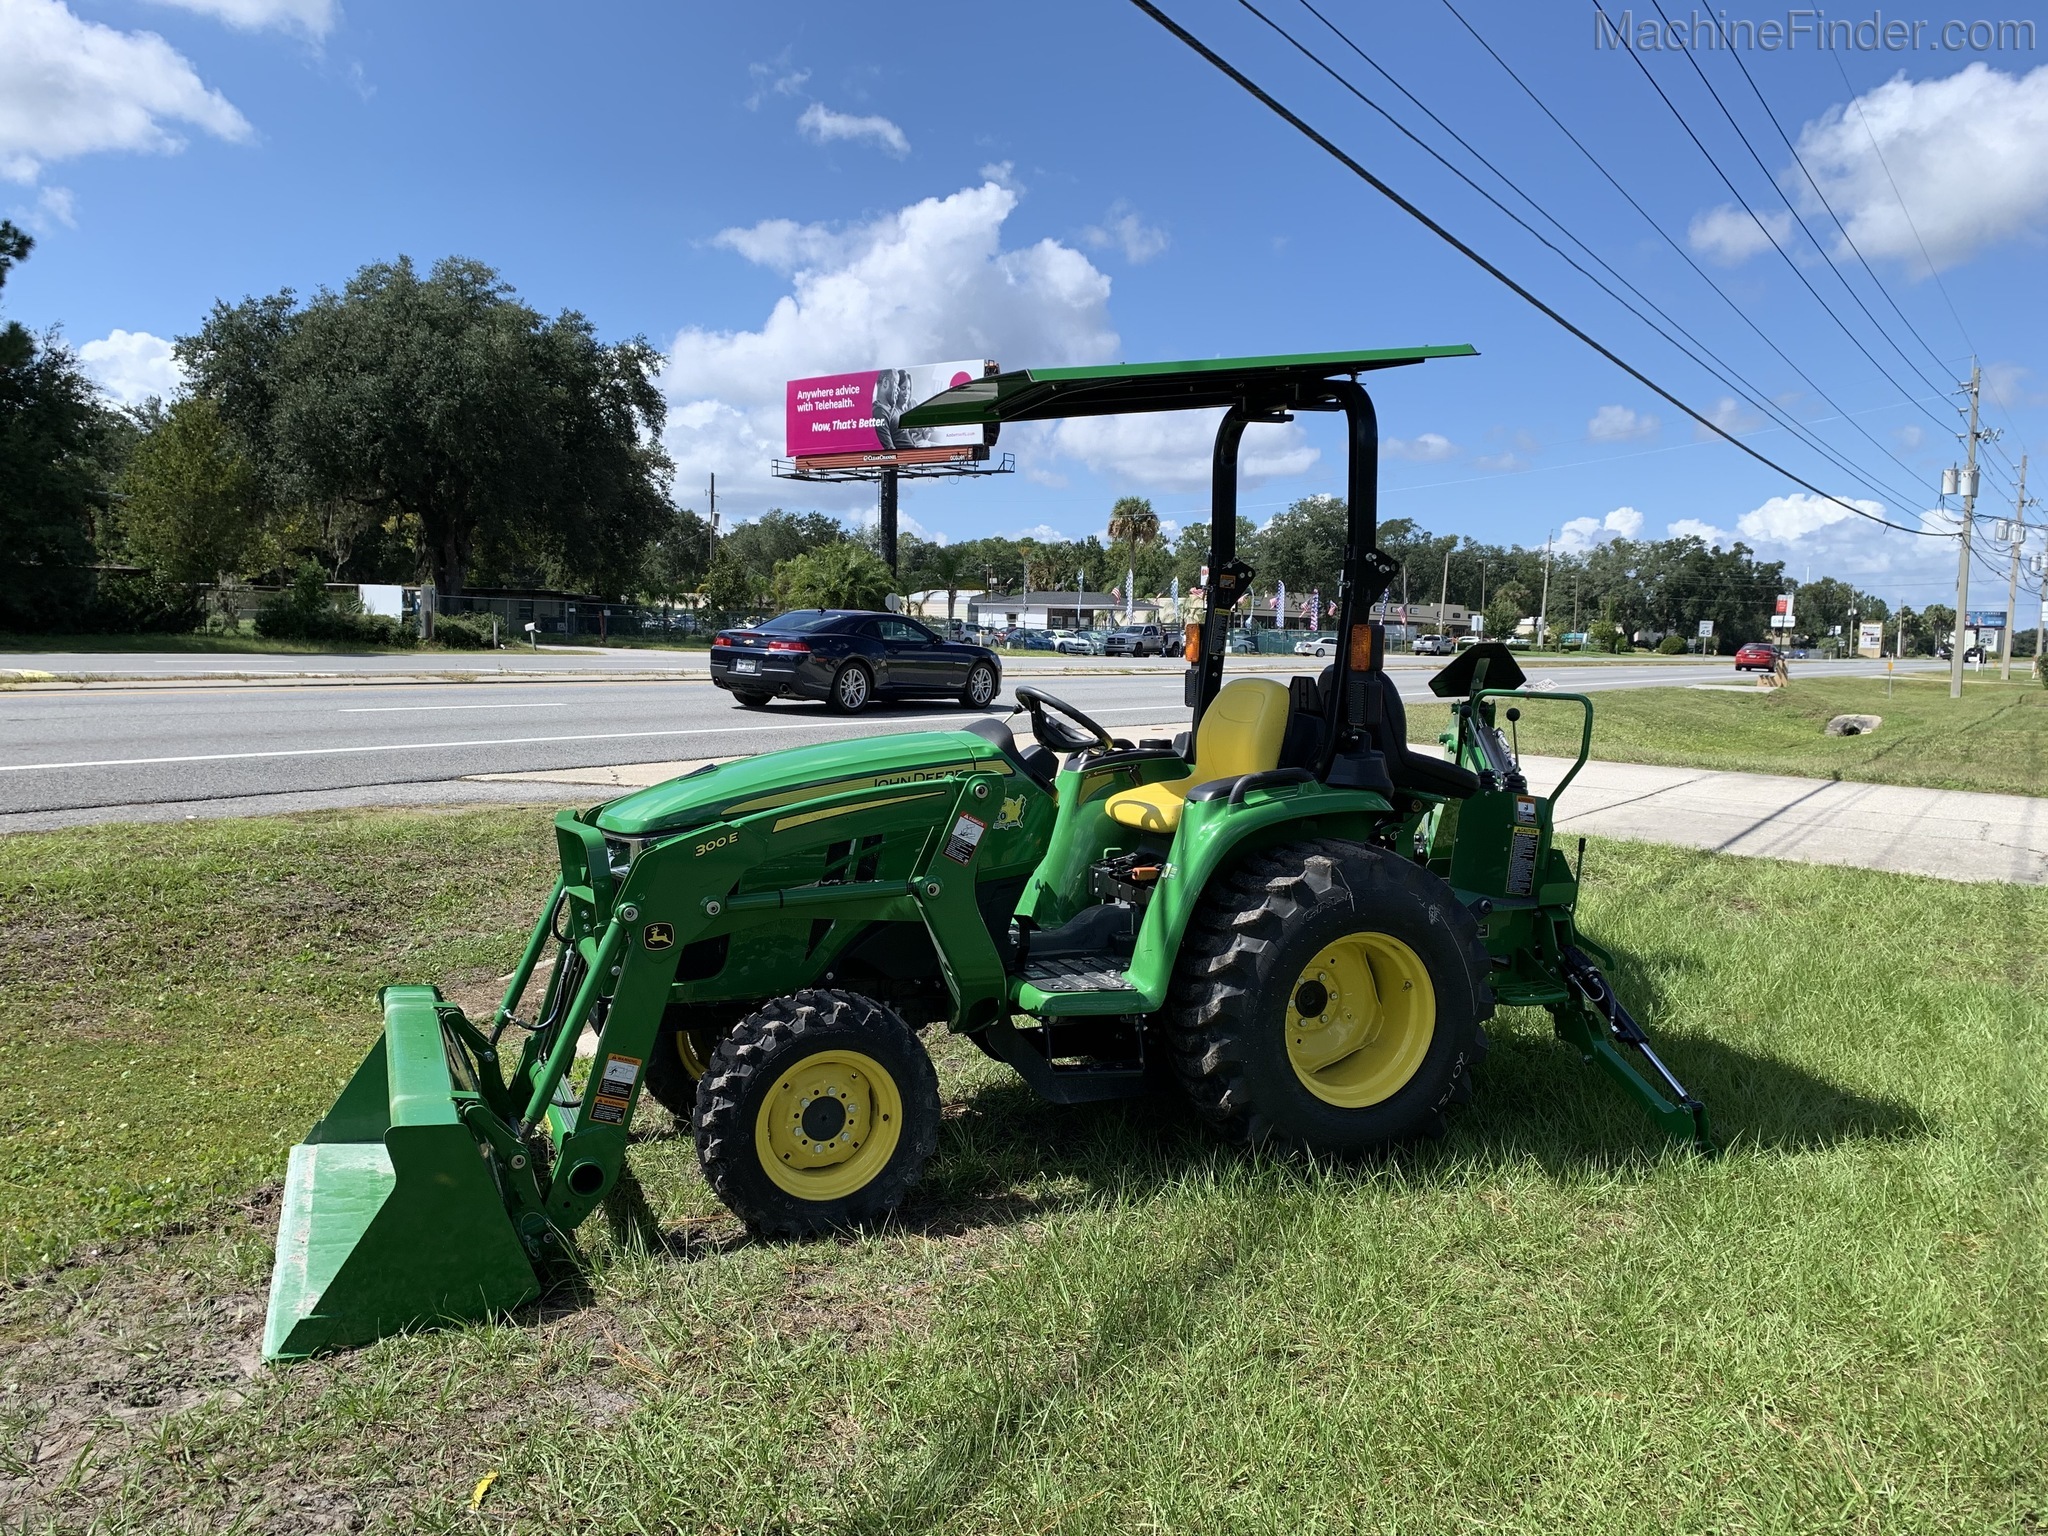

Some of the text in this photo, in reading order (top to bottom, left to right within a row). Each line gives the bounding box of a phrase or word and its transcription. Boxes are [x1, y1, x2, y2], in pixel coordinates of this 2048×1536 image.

[797, 384, 860, 401] Anywhere advice
[797, 398, 855, 412] with Telehealth.
[812, 417, 885, 432] Now, That's Better.
[695, 837, 727, 857] 300
